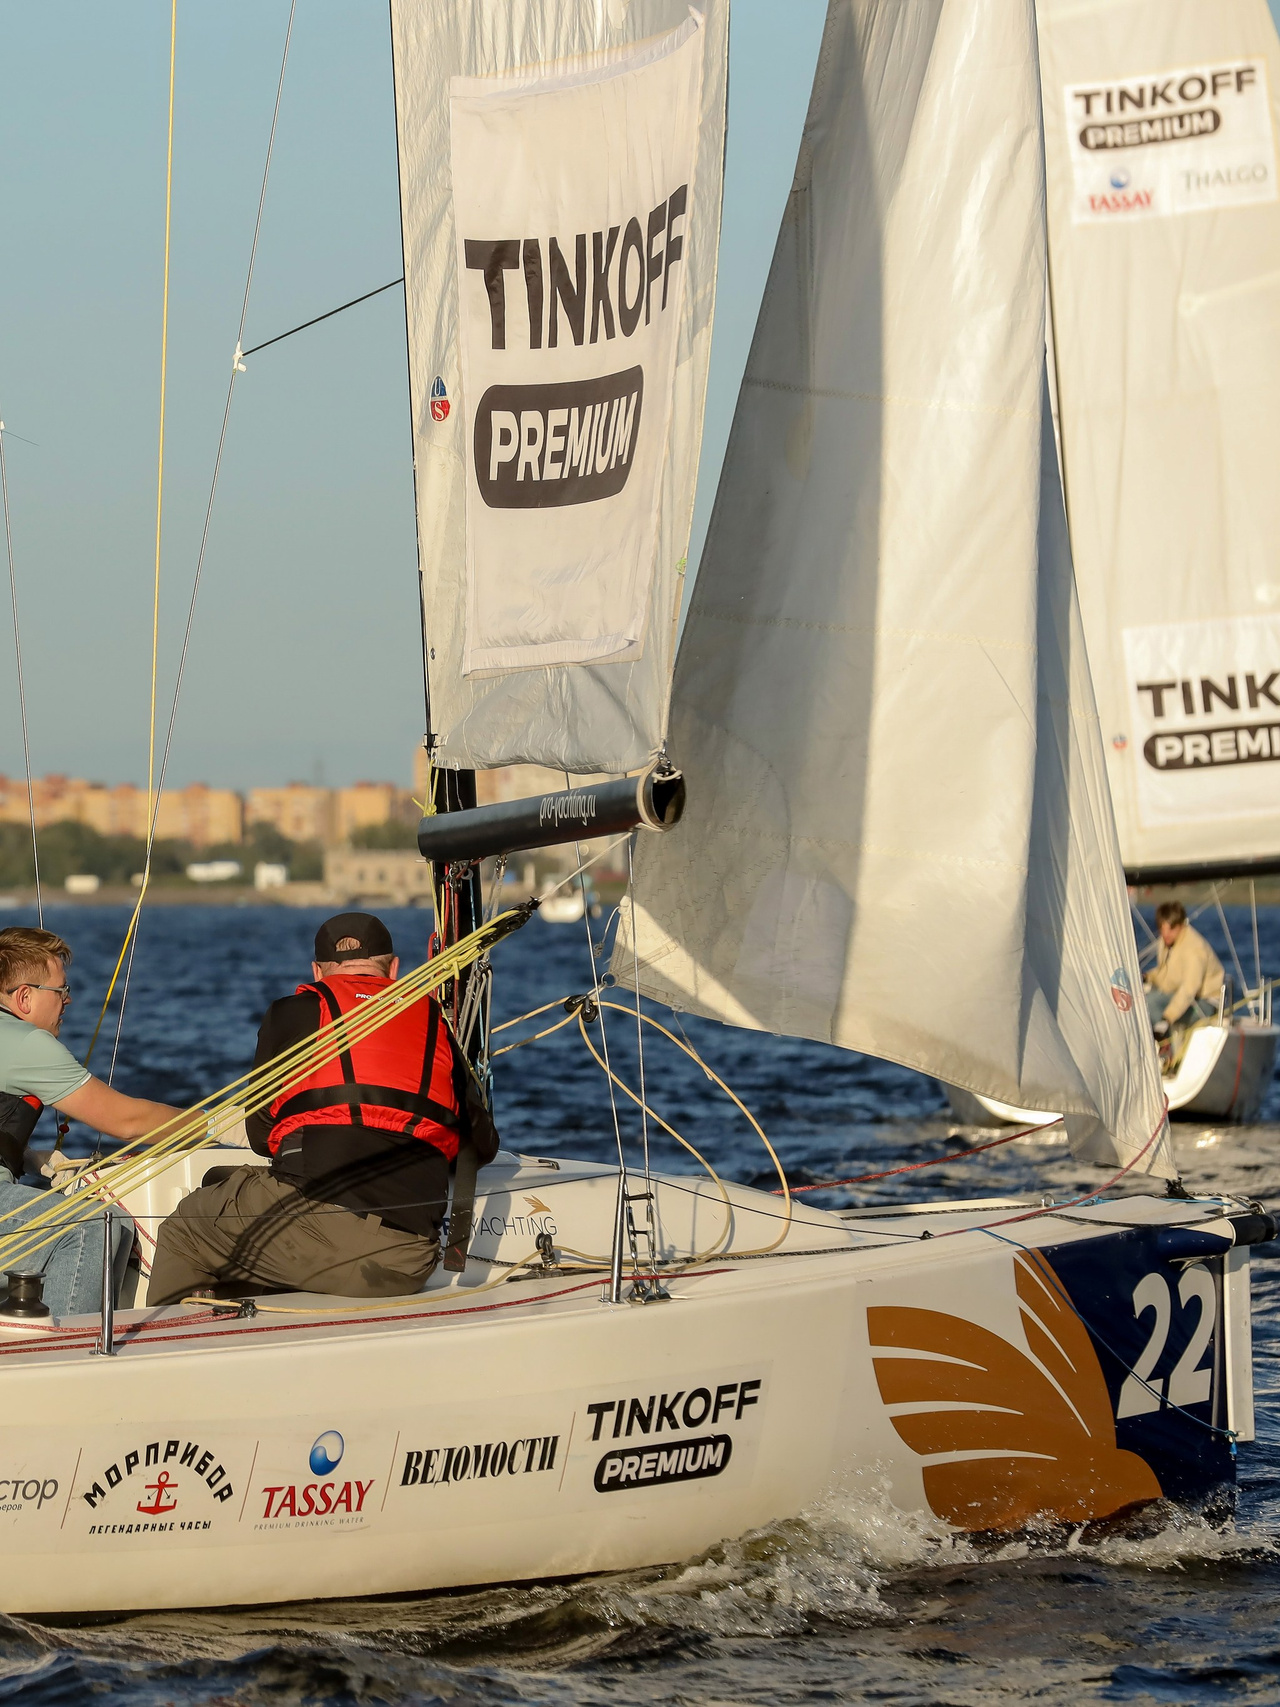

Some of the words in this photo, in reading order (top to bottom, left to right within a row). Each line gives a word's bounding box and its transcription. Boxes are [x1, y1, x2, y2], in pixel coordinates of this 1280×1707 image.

[1074, 68, 1255, 115] TINKOFF
[1086, 110, 1215, 148] PREMIUM
[464, 184, 688, 349] TINKOFF
[488, 391, 638, 481] PREMIUM
[1137, 671, 1280, 717] TINK
[1155, 727, 1280, 766] PREMI
[540, 789, 596, 827] pro-yachting.ru
[1117, 1263, 1216, 1419] 22
[587, 1379, 761, 1441] TINKOFF
[83, 1440, 234, 1509] МОРПРИБОР
[399, 1435, 560, 1488] ВЕДОМОСТИ
[601, 1442, 726, 1484] PREMIUM
[262, 1479, 376, 1518] TASSAY
[89, 1522, 175, 1534] ЛЕГЕНДАРНЫЕ
[180, 1520, 211, 1531] ЧАСЫ
[254, 1522, 291, 1530] PREMIUM
[295, 1519, 335, 1528] DRINKING
[339, 1516, 364, 1525] WATER
